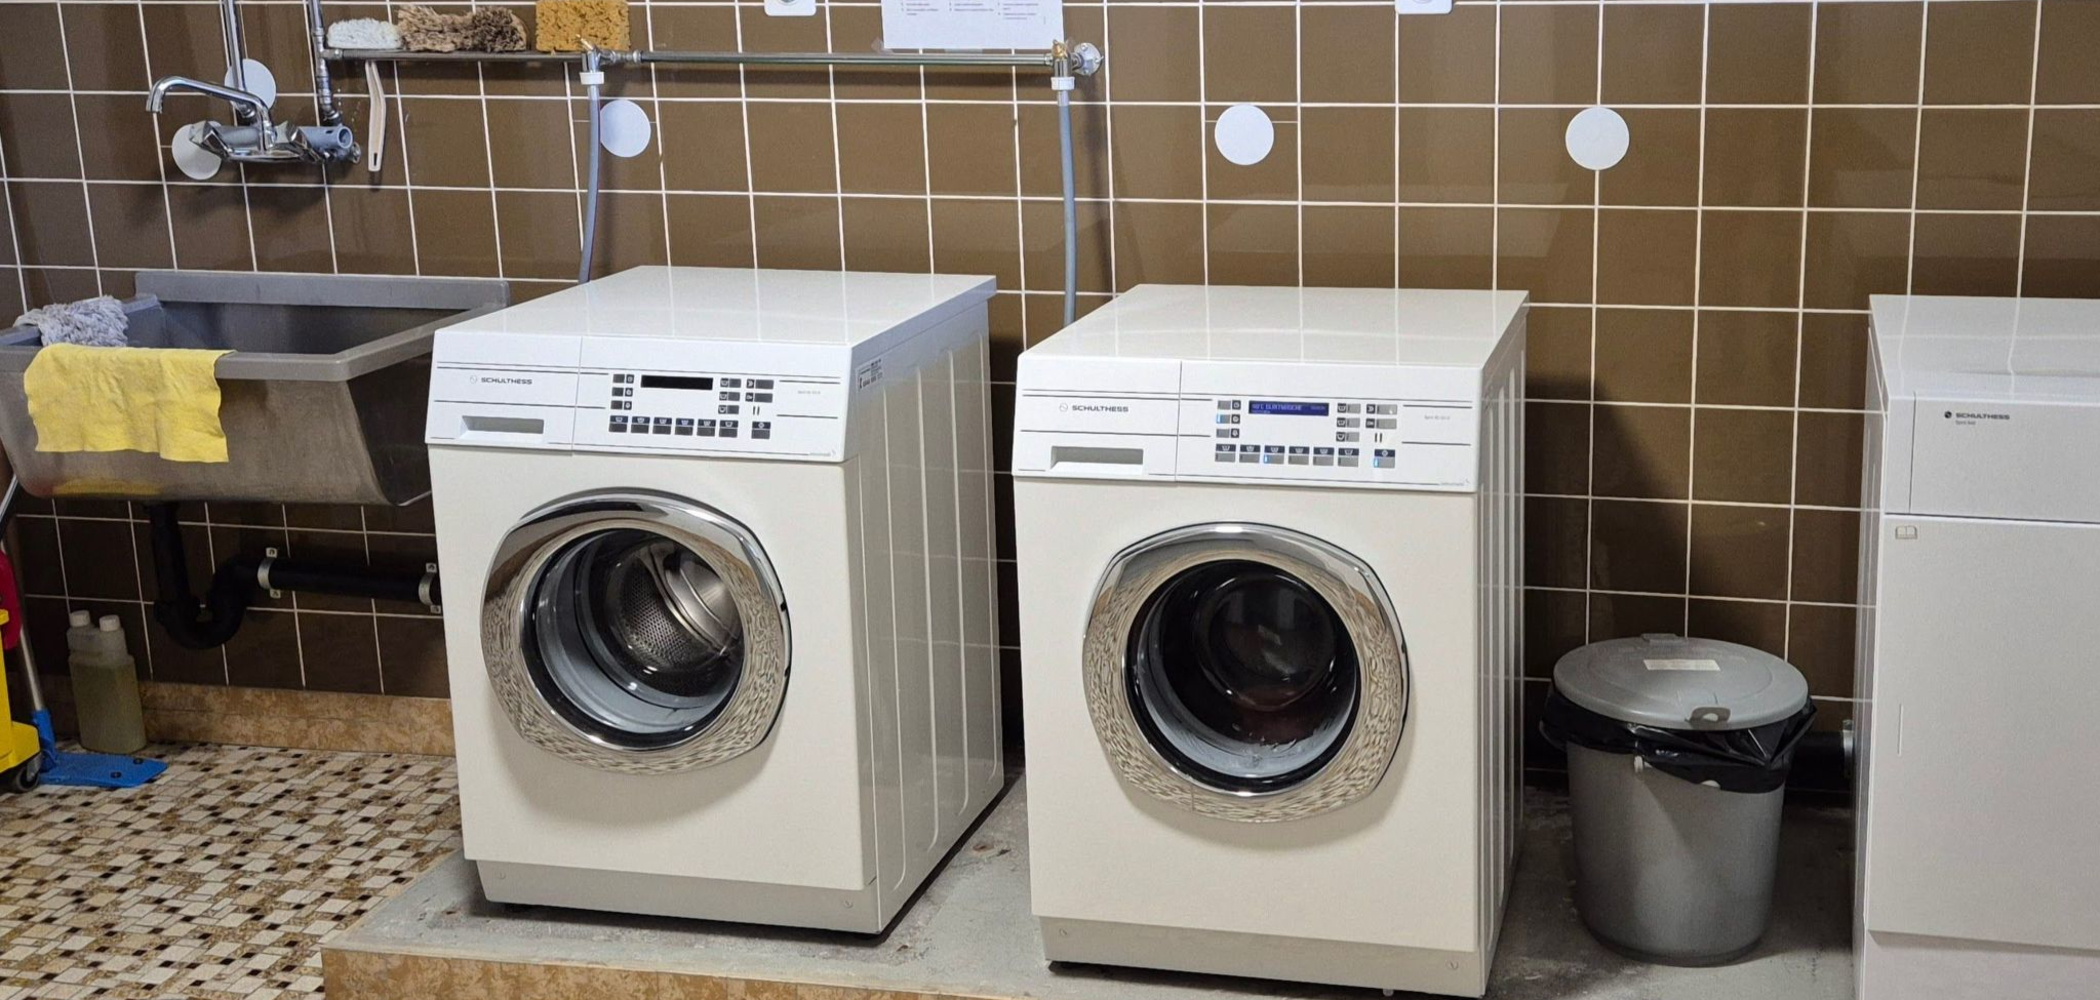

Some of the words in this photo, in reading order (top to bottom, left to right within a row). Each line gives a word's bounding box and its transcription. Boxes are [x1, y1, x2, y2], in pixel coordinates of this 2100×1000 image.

[481, 377, 532, 385] SCHULTHESS
[1072, 404, 1129, 412] SCHULTHESS
[1956, 412, 2010, 420] SCHULTHESS
